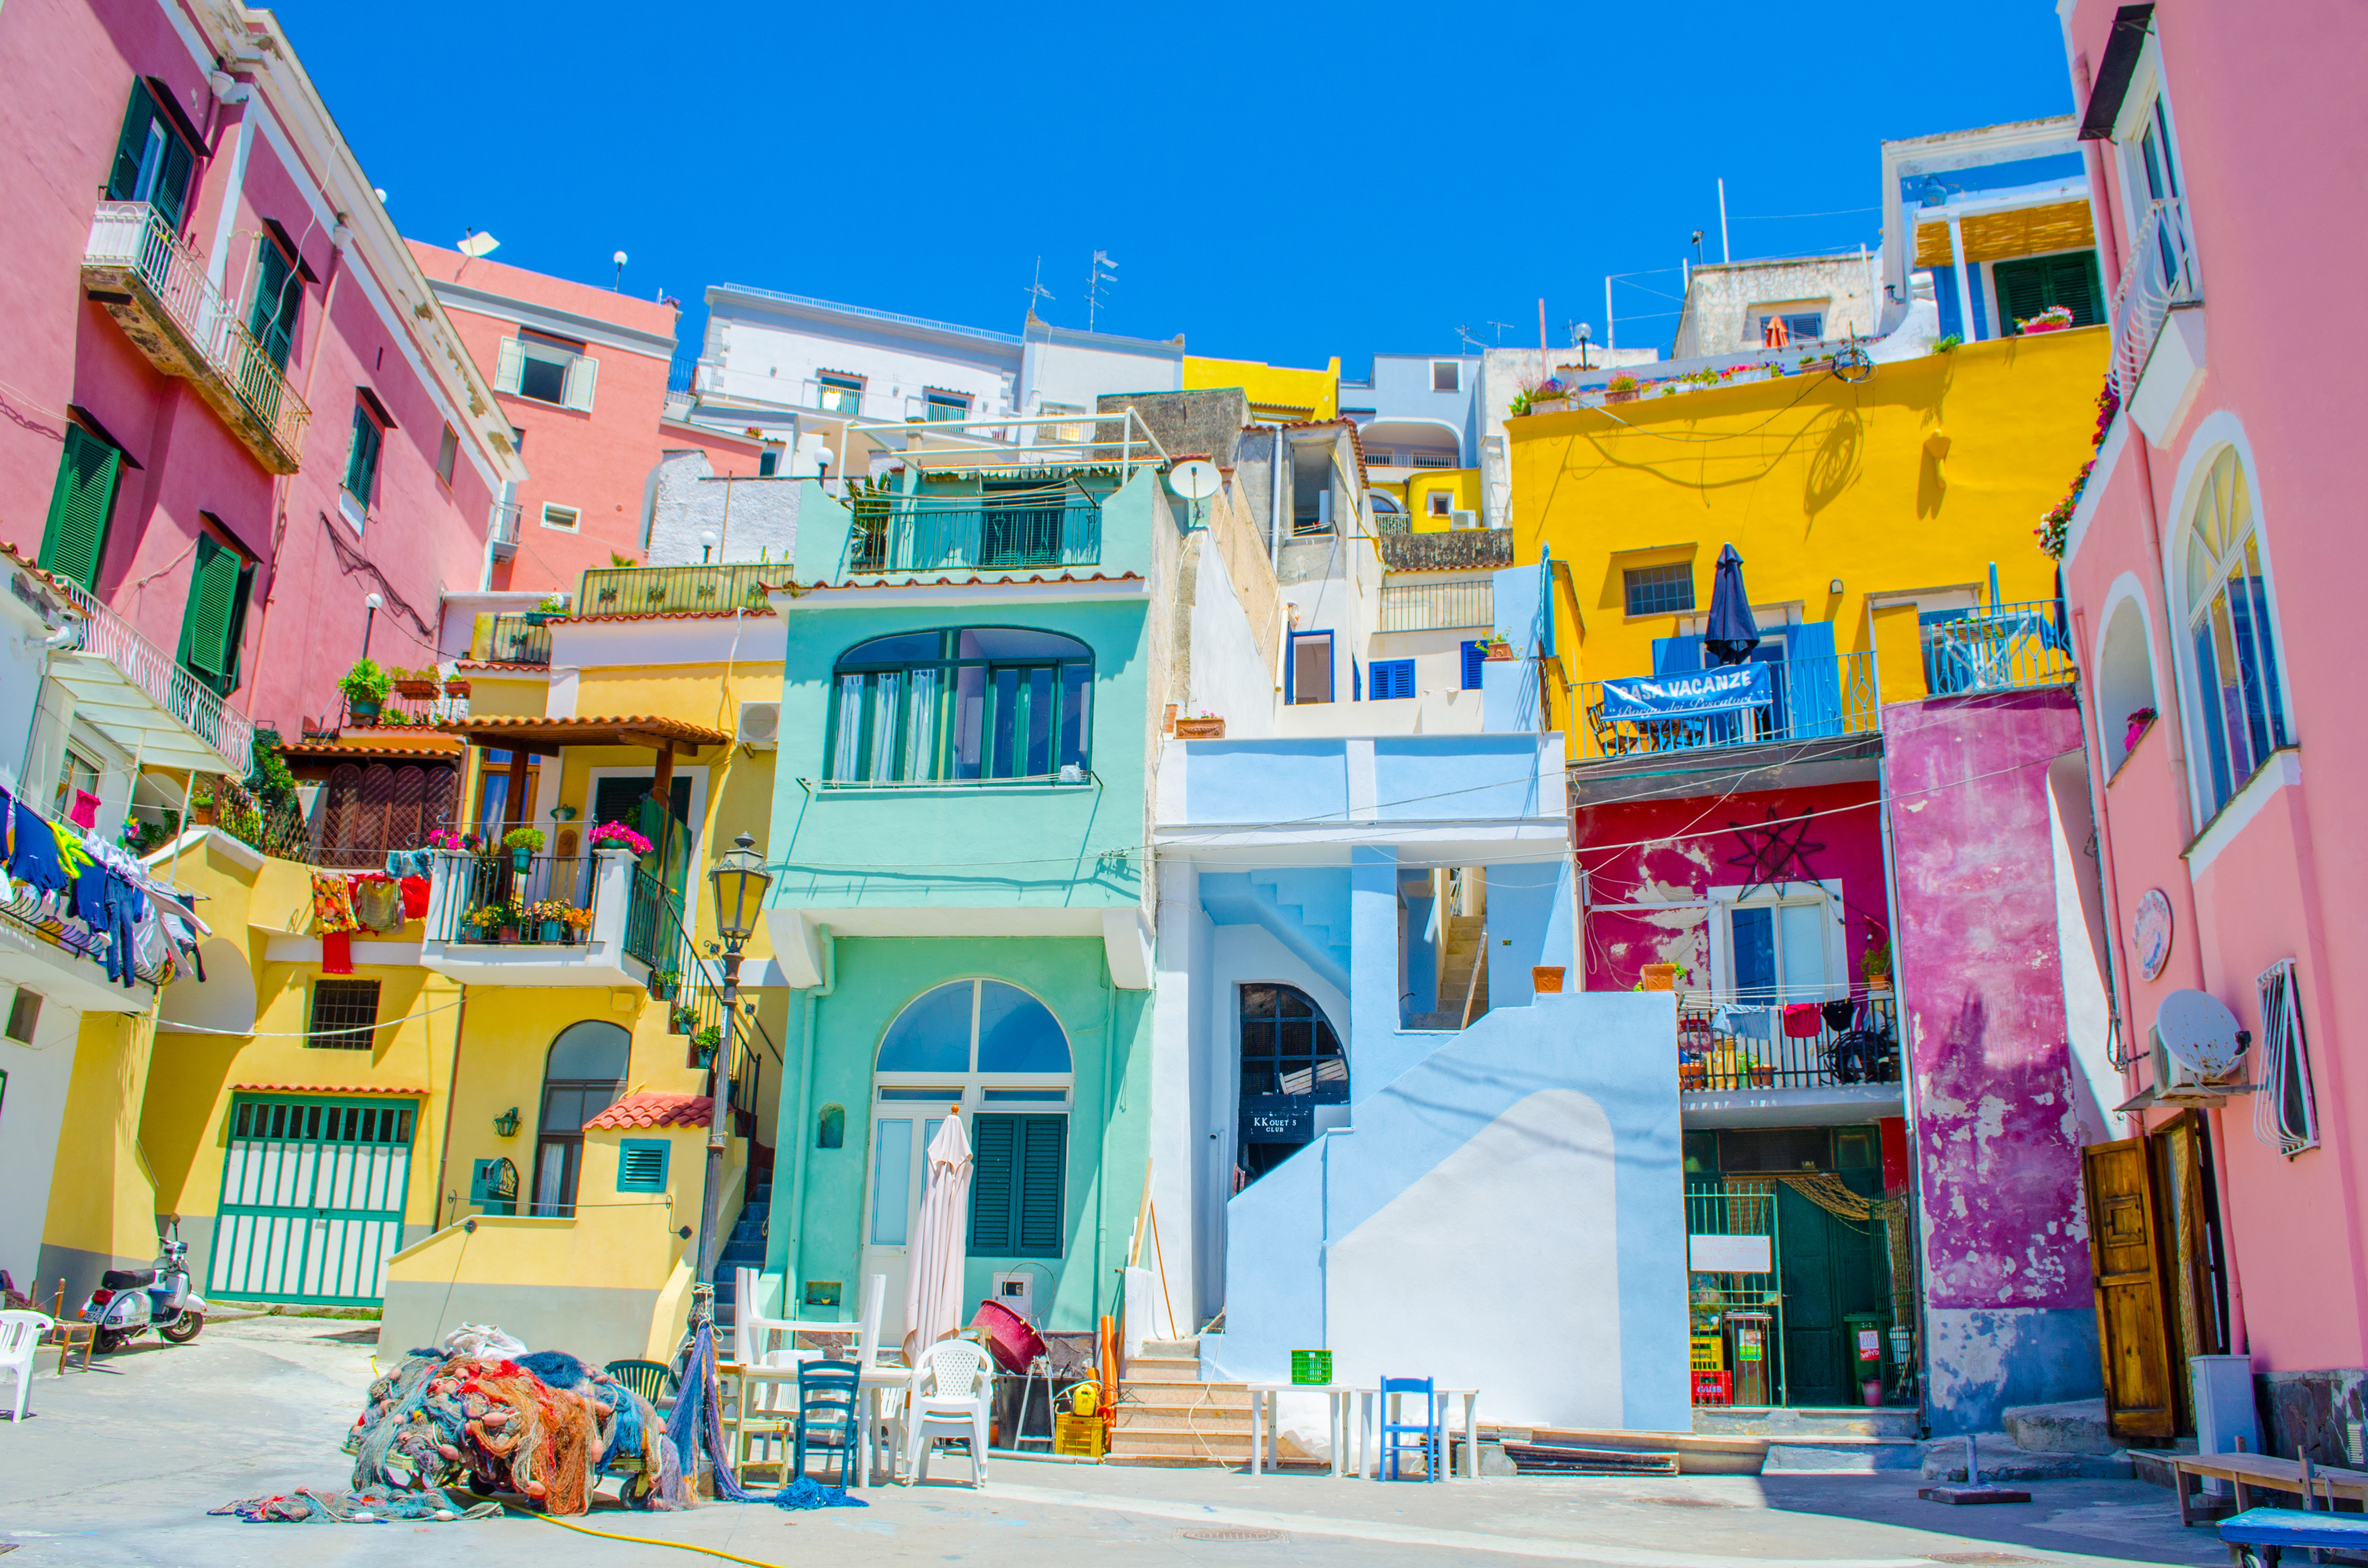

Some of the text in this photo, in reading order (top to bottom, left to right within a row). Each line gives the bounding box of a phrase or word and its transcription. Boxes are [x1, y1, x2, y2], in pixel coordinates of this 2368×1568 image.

[1619, 670, 1752, 701] CASA VACANZE
[1666, 701, 1685, 711] dei
[1861, 1349, 1879, 1358] vetro
